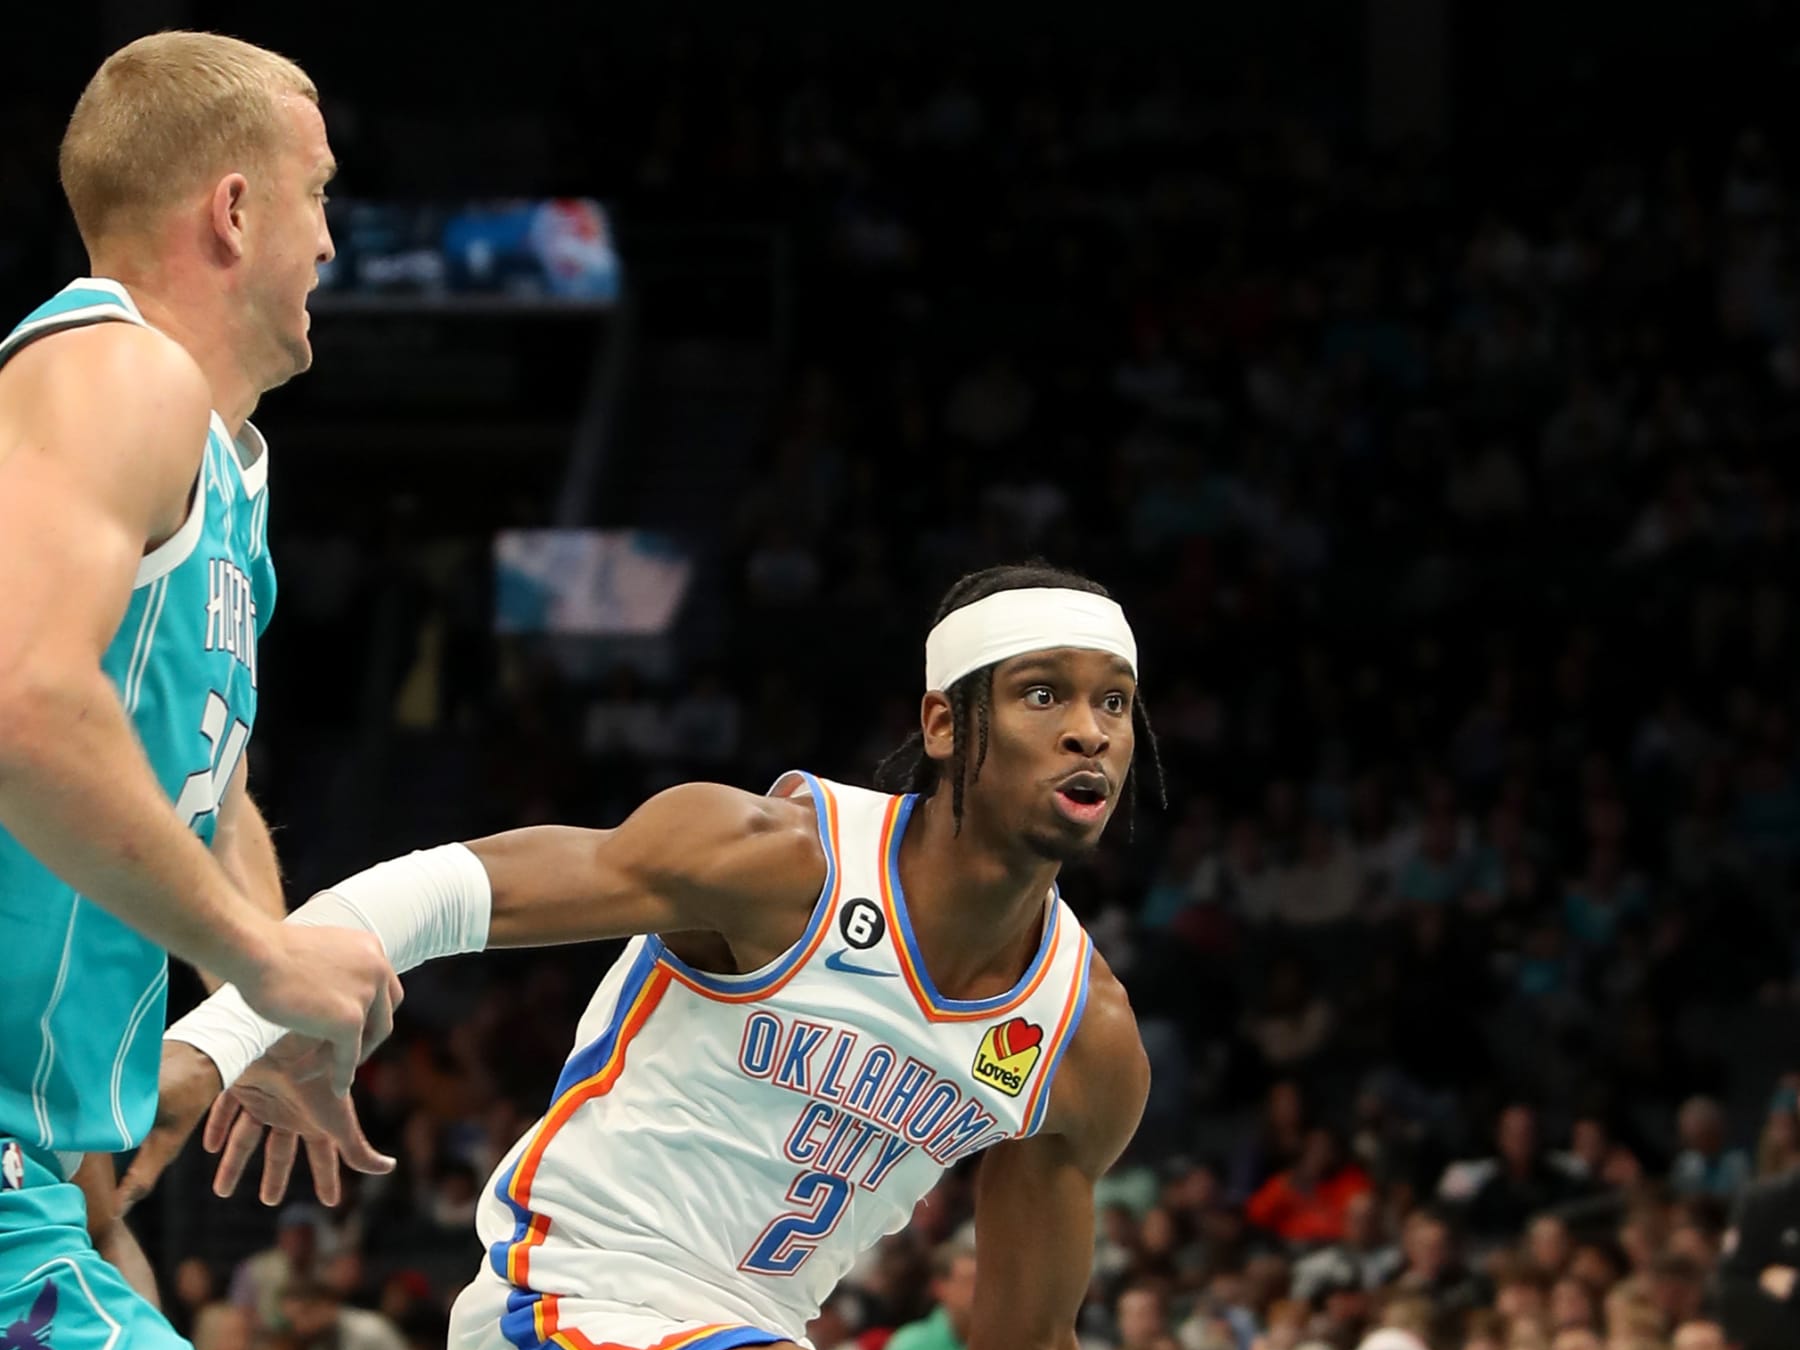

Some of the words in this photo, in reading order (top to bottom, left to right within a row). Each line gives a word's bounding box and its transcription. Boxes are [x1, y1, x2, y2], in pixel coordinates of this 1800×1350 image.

[846, 903, 876, 945] 6
[783, 1100, 915, 1192] CITY
[737, 1169, 855, 1277] 2
